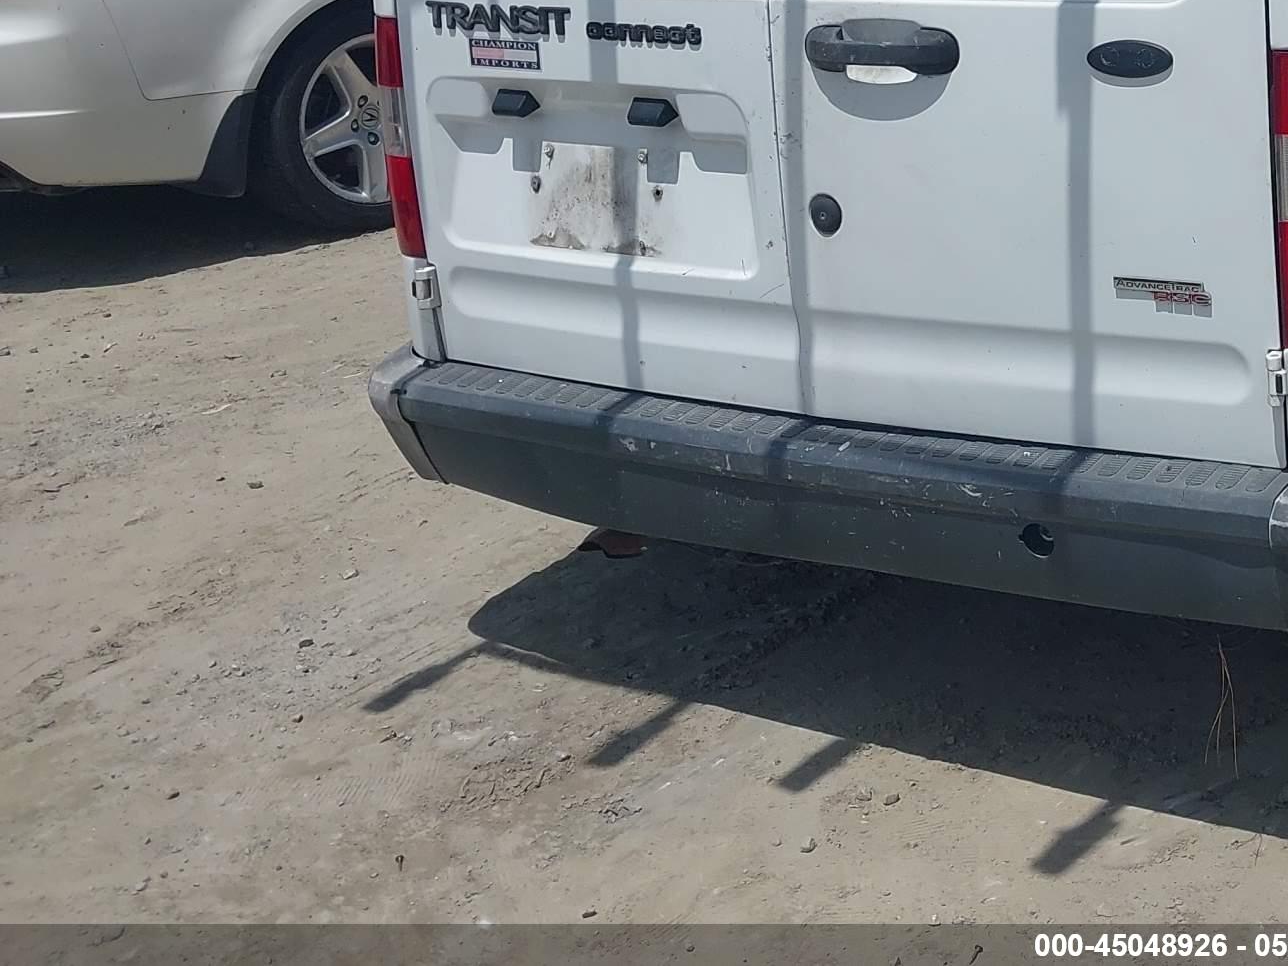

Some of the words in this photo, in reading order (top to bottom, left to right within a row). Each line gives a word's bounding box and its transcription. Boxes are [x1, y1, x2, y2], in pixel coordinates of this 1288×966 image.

[425, 0, 571, 37] TRANSIT
[586, 21, 702, 45] connect
[471, 39, 536, 50] CHAMPION
[474, 58, 538, 69] IMPORTS
